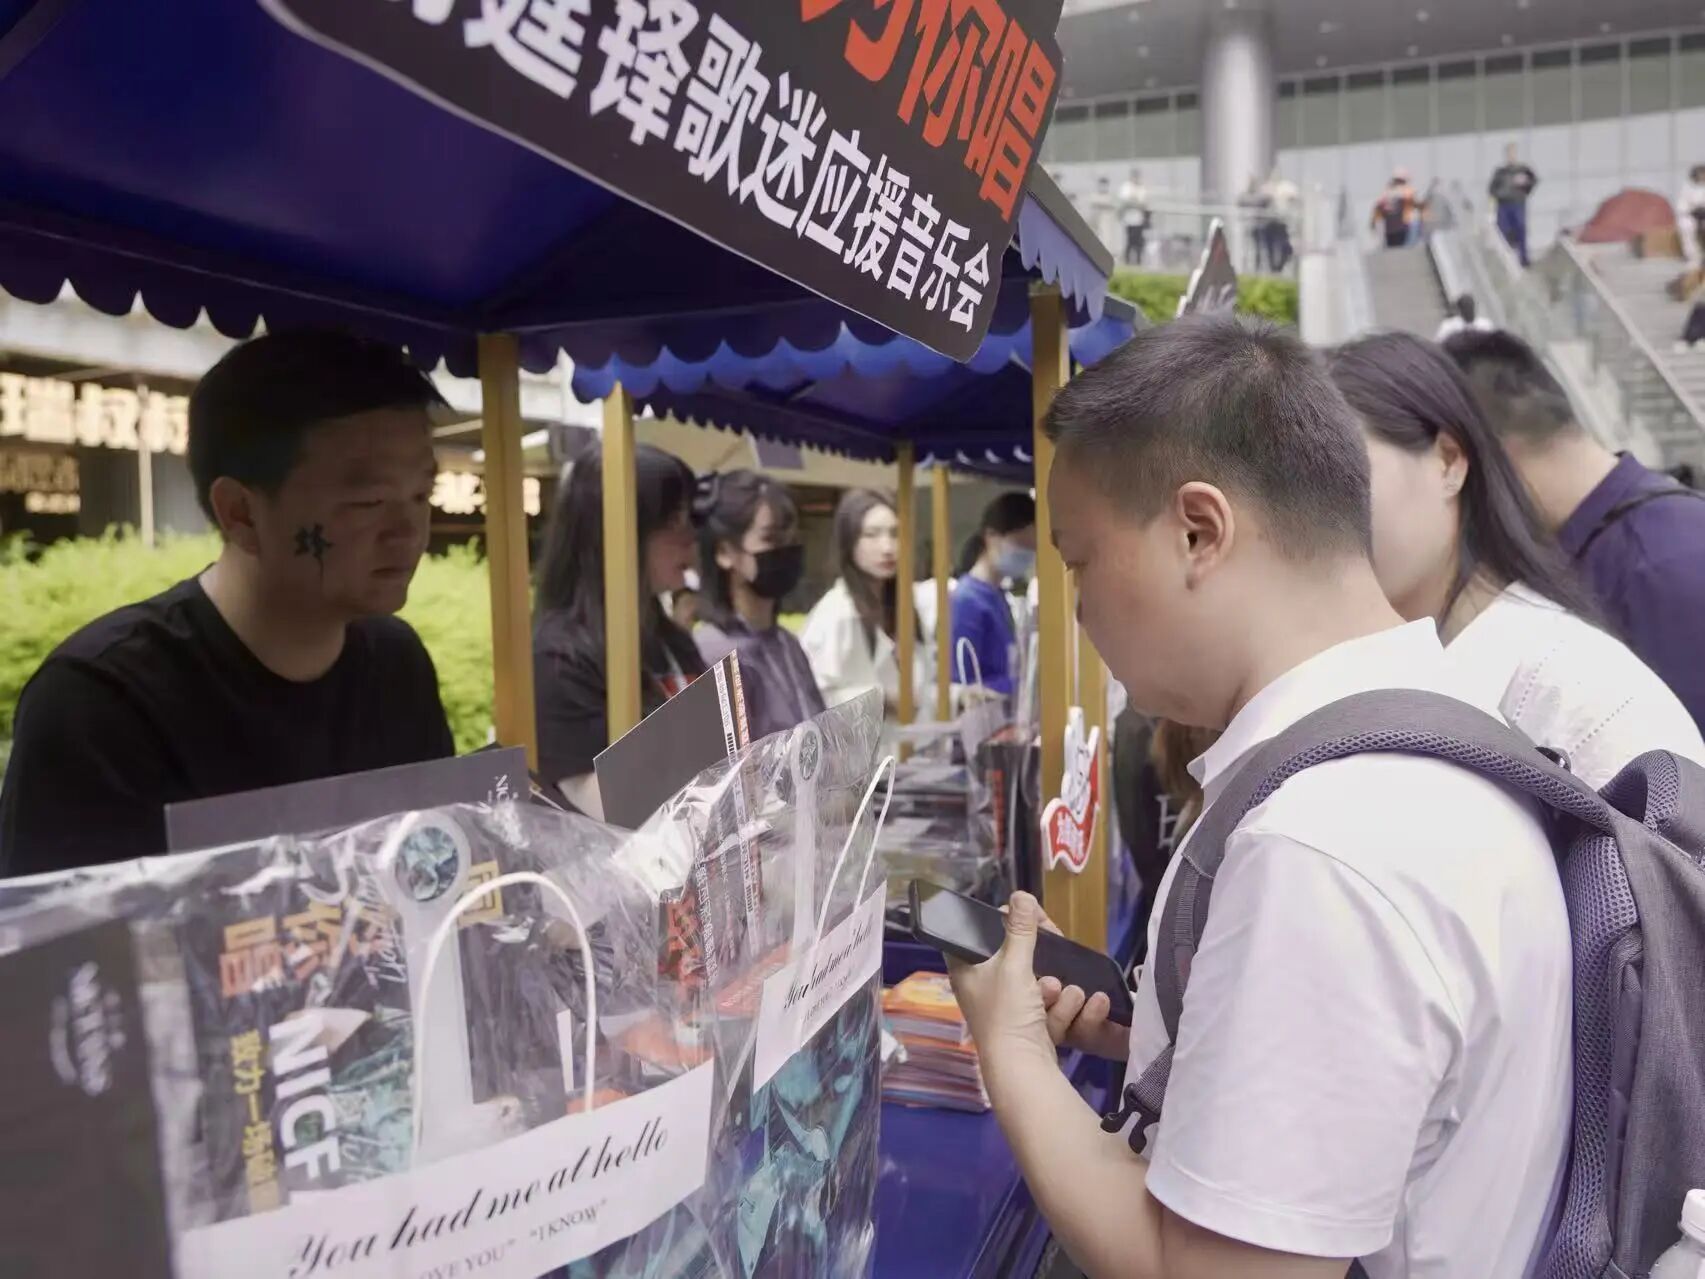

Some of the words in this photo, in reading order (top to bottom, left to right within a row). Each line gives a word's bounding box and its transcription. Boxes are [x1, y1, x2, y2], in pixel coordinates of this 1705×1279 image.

[413, 0, 990, 332] 锋歌迷应援音乐会
[289, 1233, 377, 1278] You
[389, 1188, 483, 1251] had
[487, 1181, 541, 1220] me
[548, 1146, 591, 1191] at
[592, 1117, 669, 1179] hello
